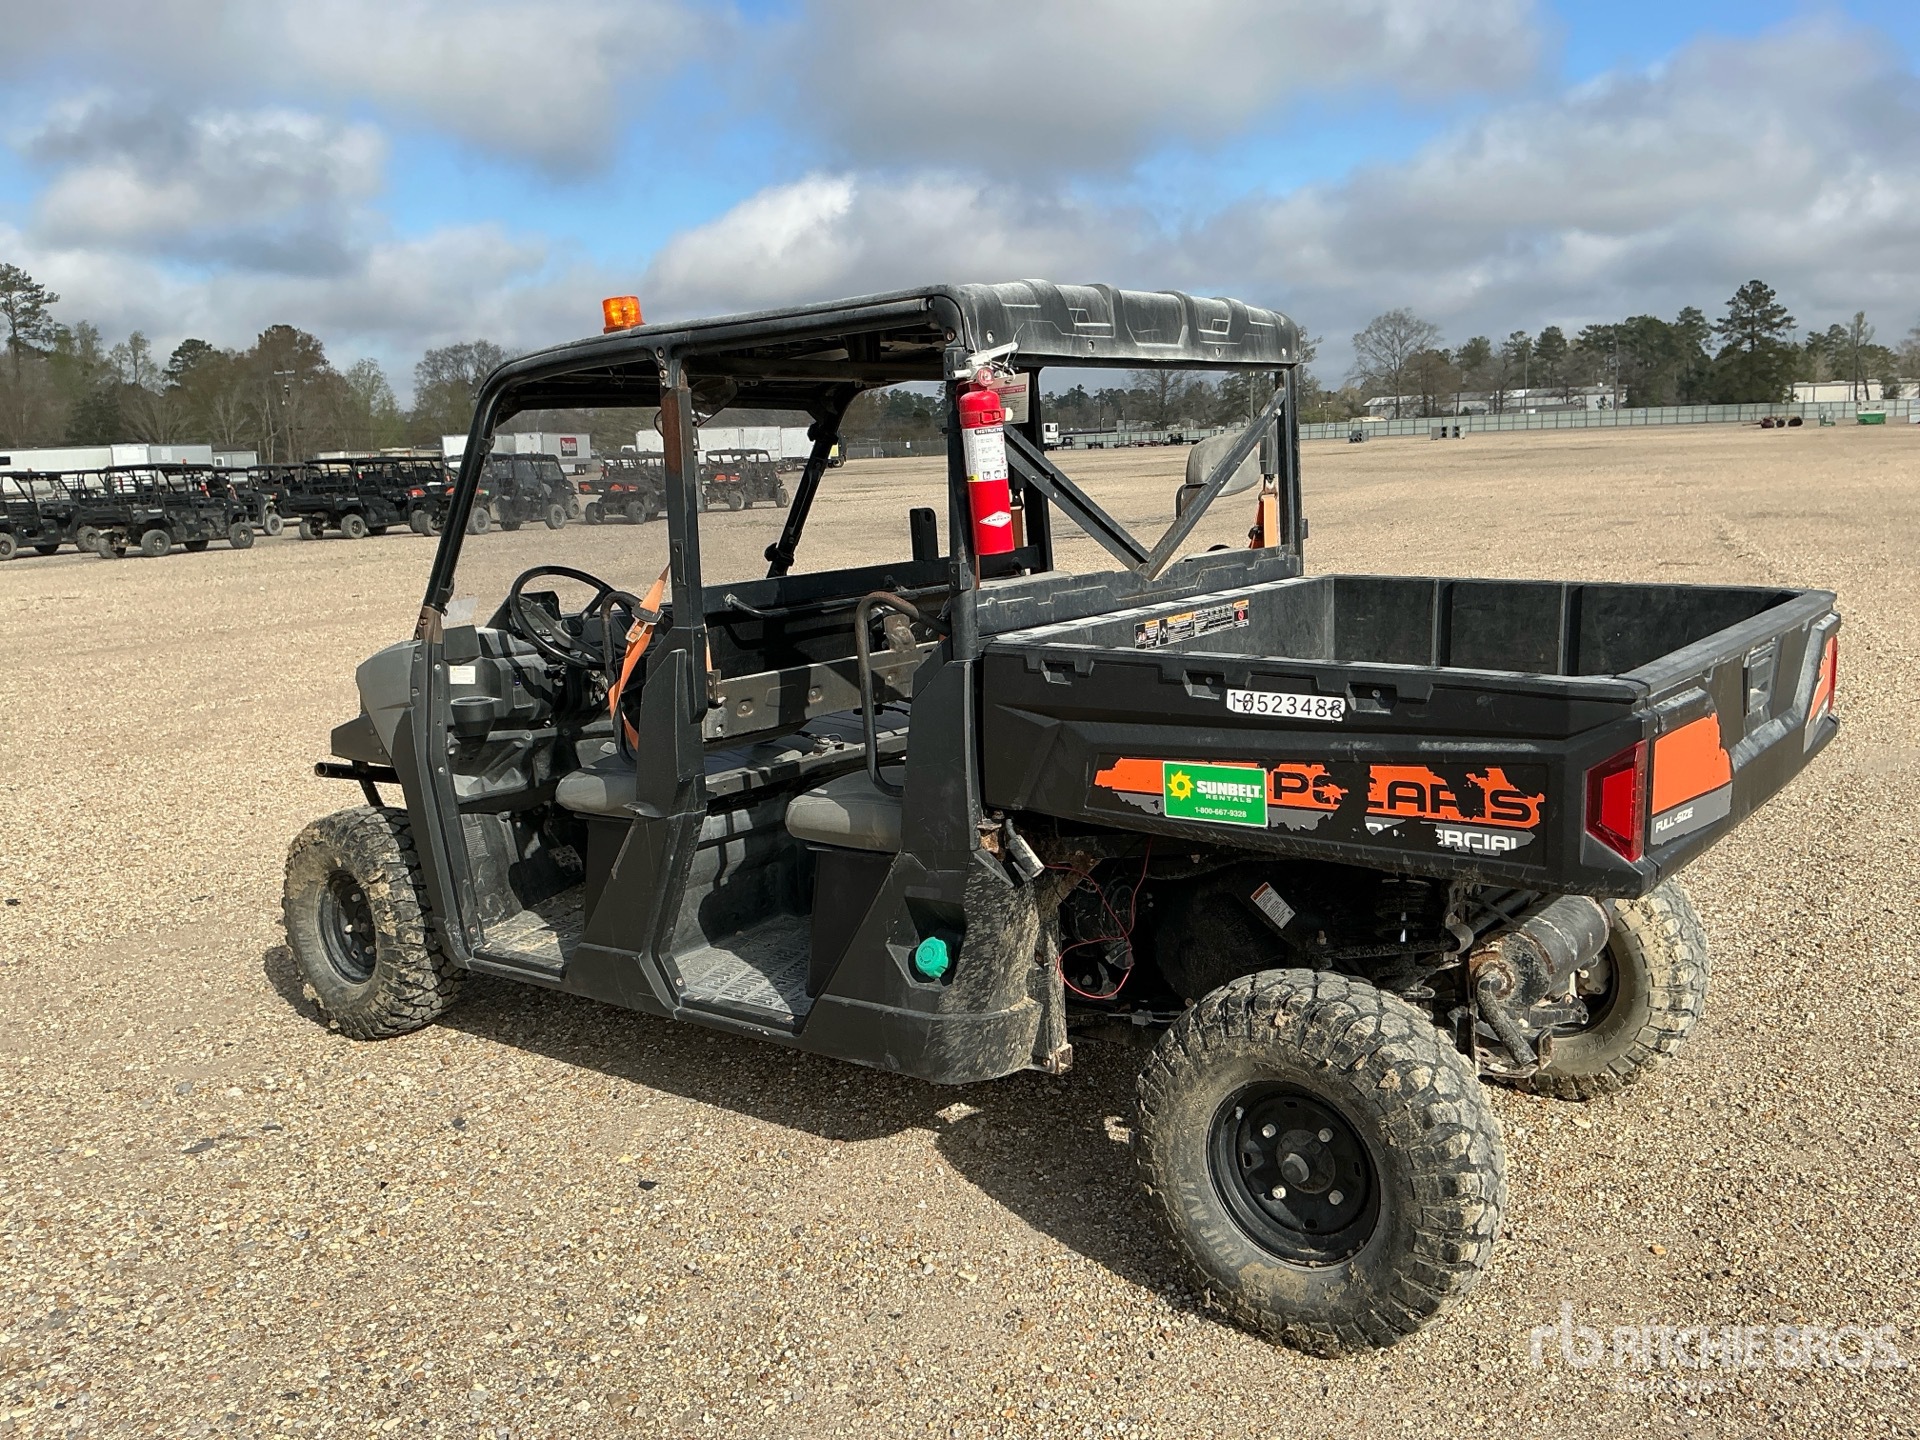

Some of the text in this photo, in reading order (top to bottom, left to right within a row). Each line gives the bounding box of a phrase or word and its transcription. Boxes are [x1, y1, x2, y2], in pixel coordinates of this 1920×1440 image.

[1230, 691, 1342, 719] 10523488
[1196, 780, 1262, 798] SUNBELT
[1205, 794, 1252, 803] RENTALS
[1194, 806, 1247, 818] 1-800-667-9328
[1655, 806, 1694, 834] FULL-SIZE
